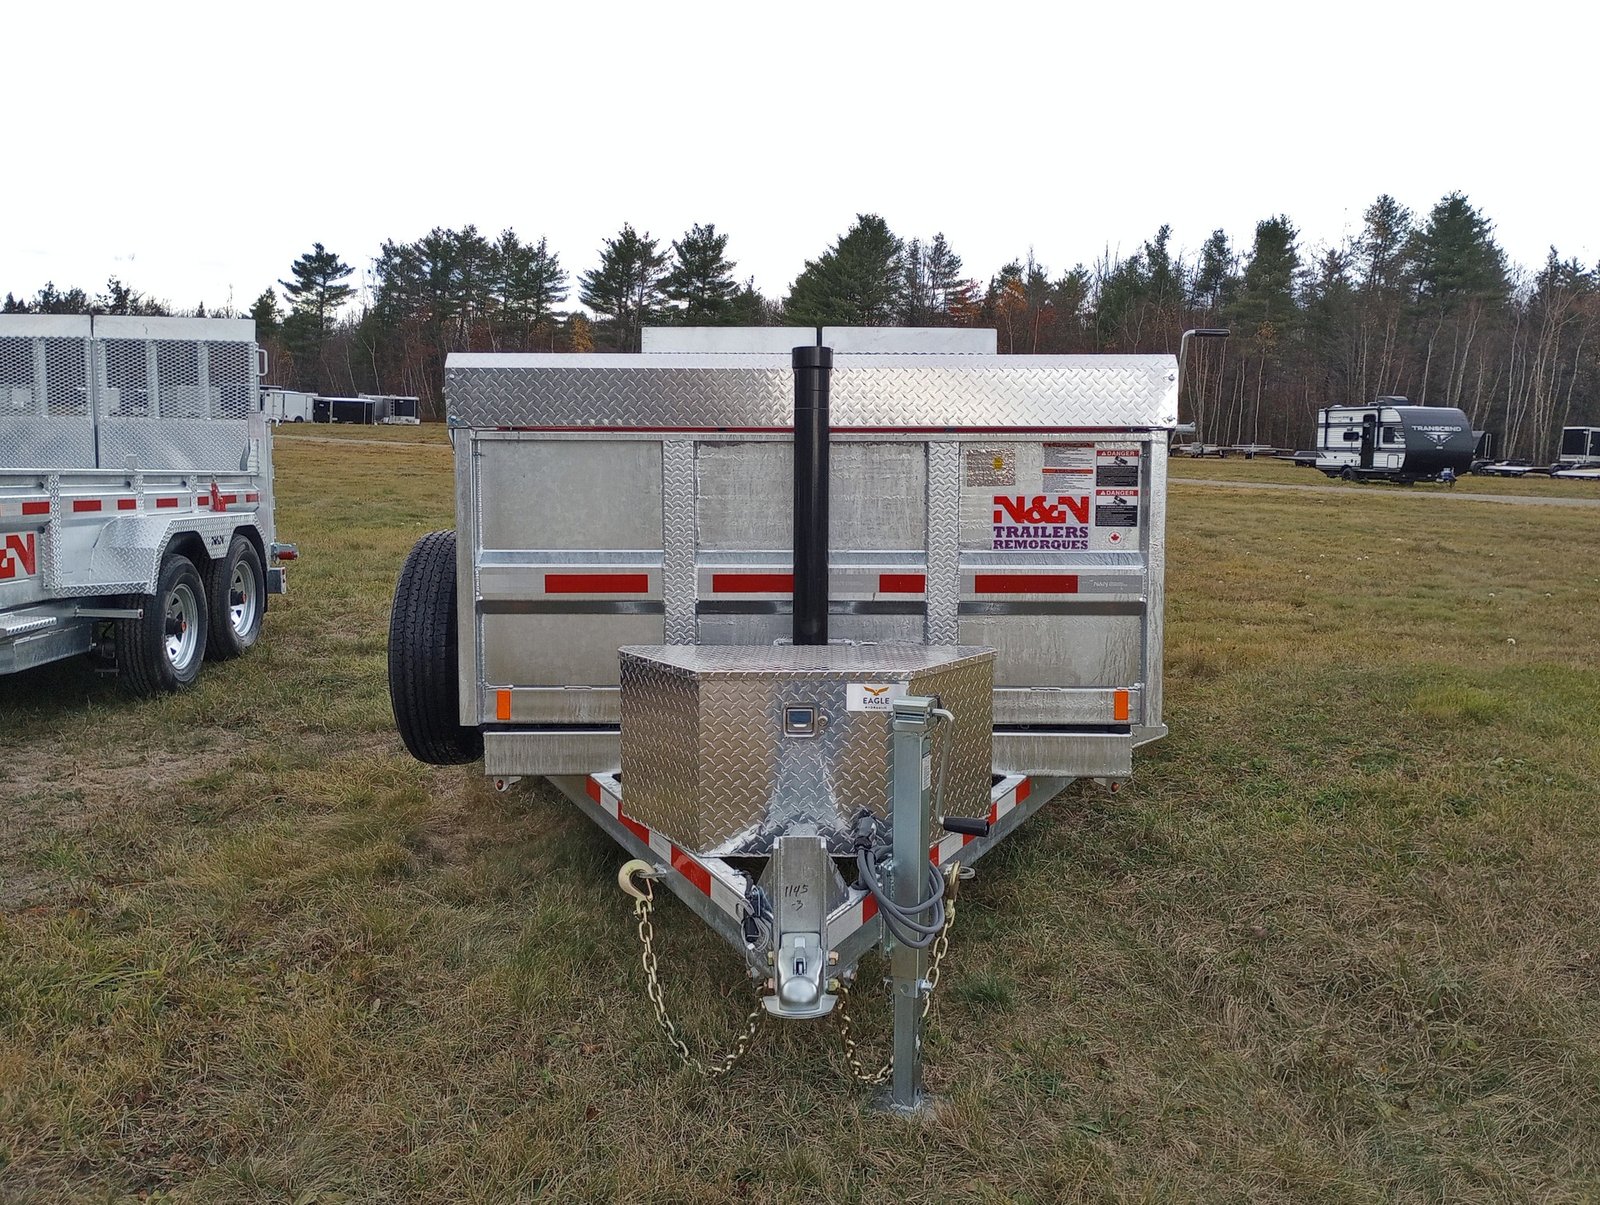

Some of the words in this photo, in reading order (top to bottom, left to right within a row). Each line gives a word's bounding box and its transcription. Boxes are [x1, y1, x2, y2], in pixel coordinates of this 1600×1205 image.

[993, 496, 1089, 523] N&N
[993, 526, 1089, 538] TRAILERS
[993, 540, 1089, 550] REMORQUES
[785, 884, 809, 897] 1145
